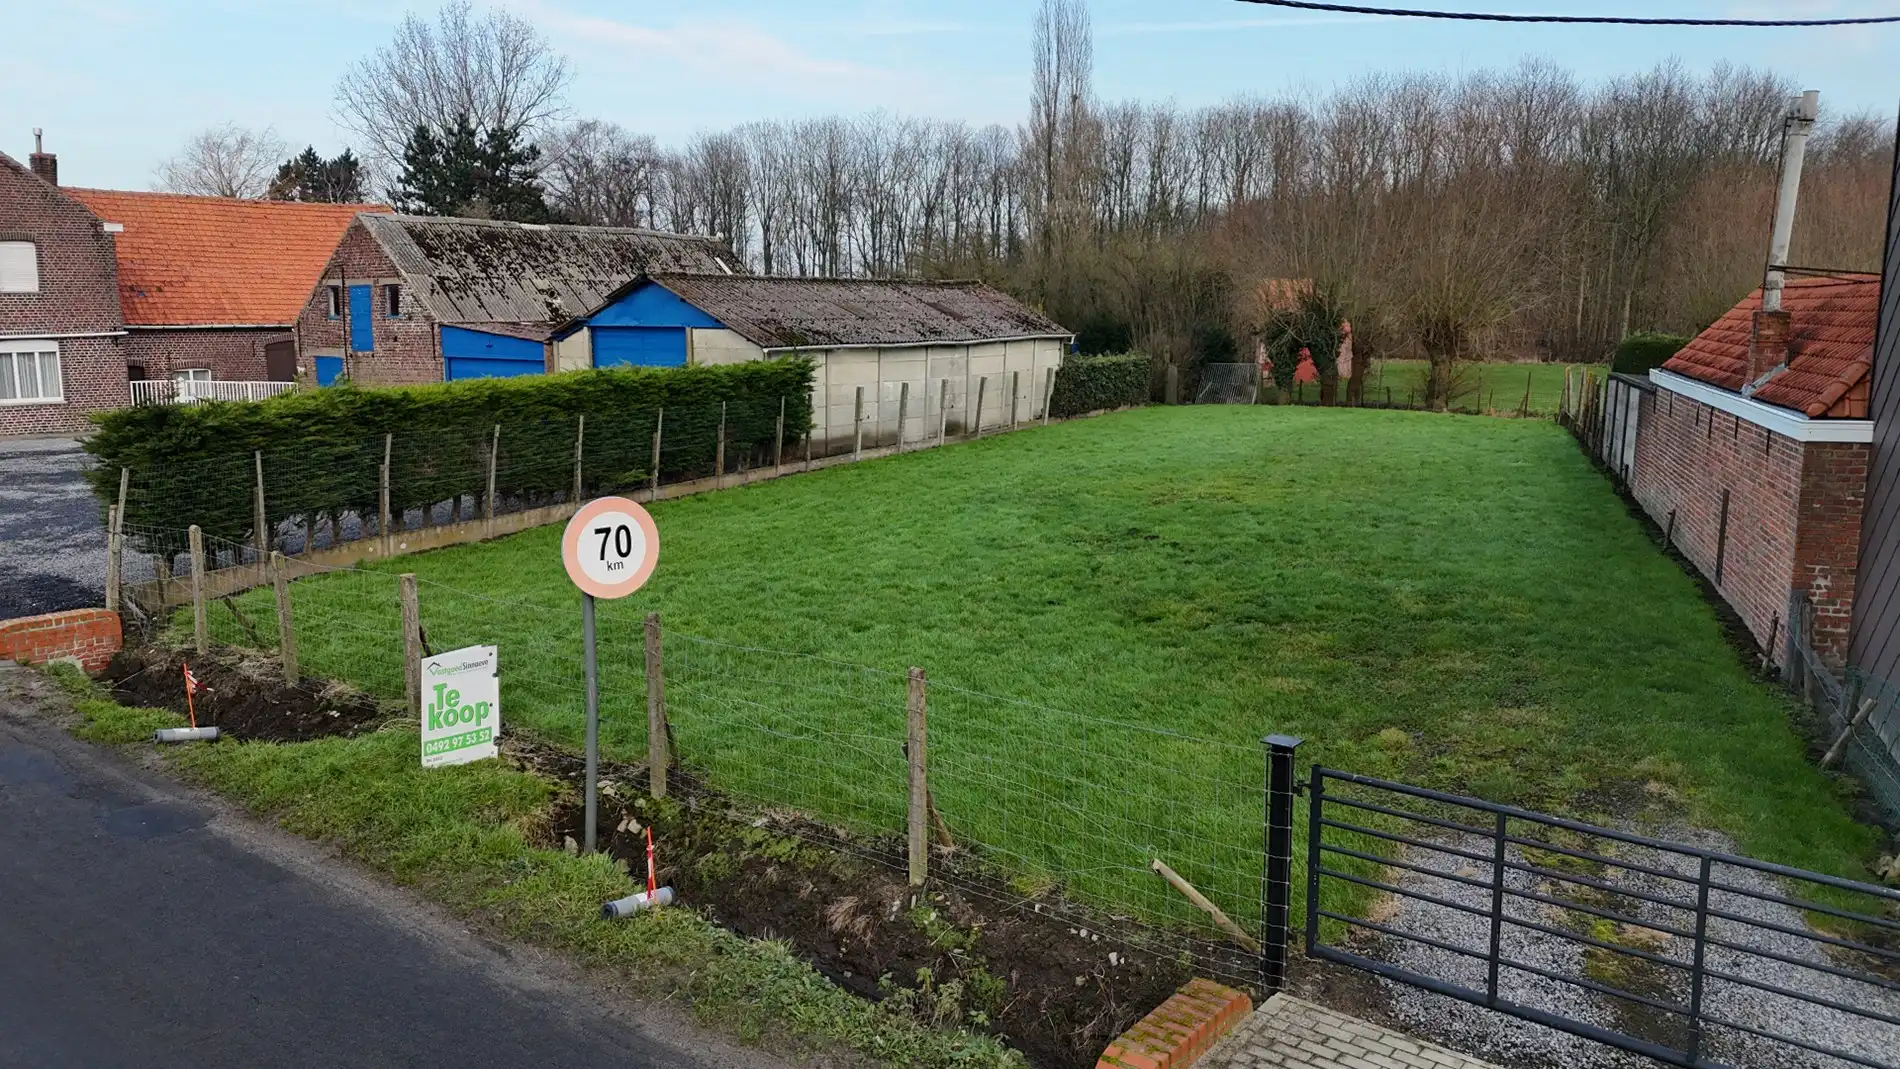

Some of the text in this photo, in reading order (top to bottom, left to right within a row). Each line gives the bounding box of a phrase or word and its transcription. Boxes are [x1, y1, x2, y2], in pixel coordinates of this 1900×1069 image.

[594, 524, 632, 561] 70
[606, 560, 624, 572] km
[433, 682, 460, 710] Te
[428, 701, 489, 731] koop
[426, 730, 490, 753] 0492 97 53 52
